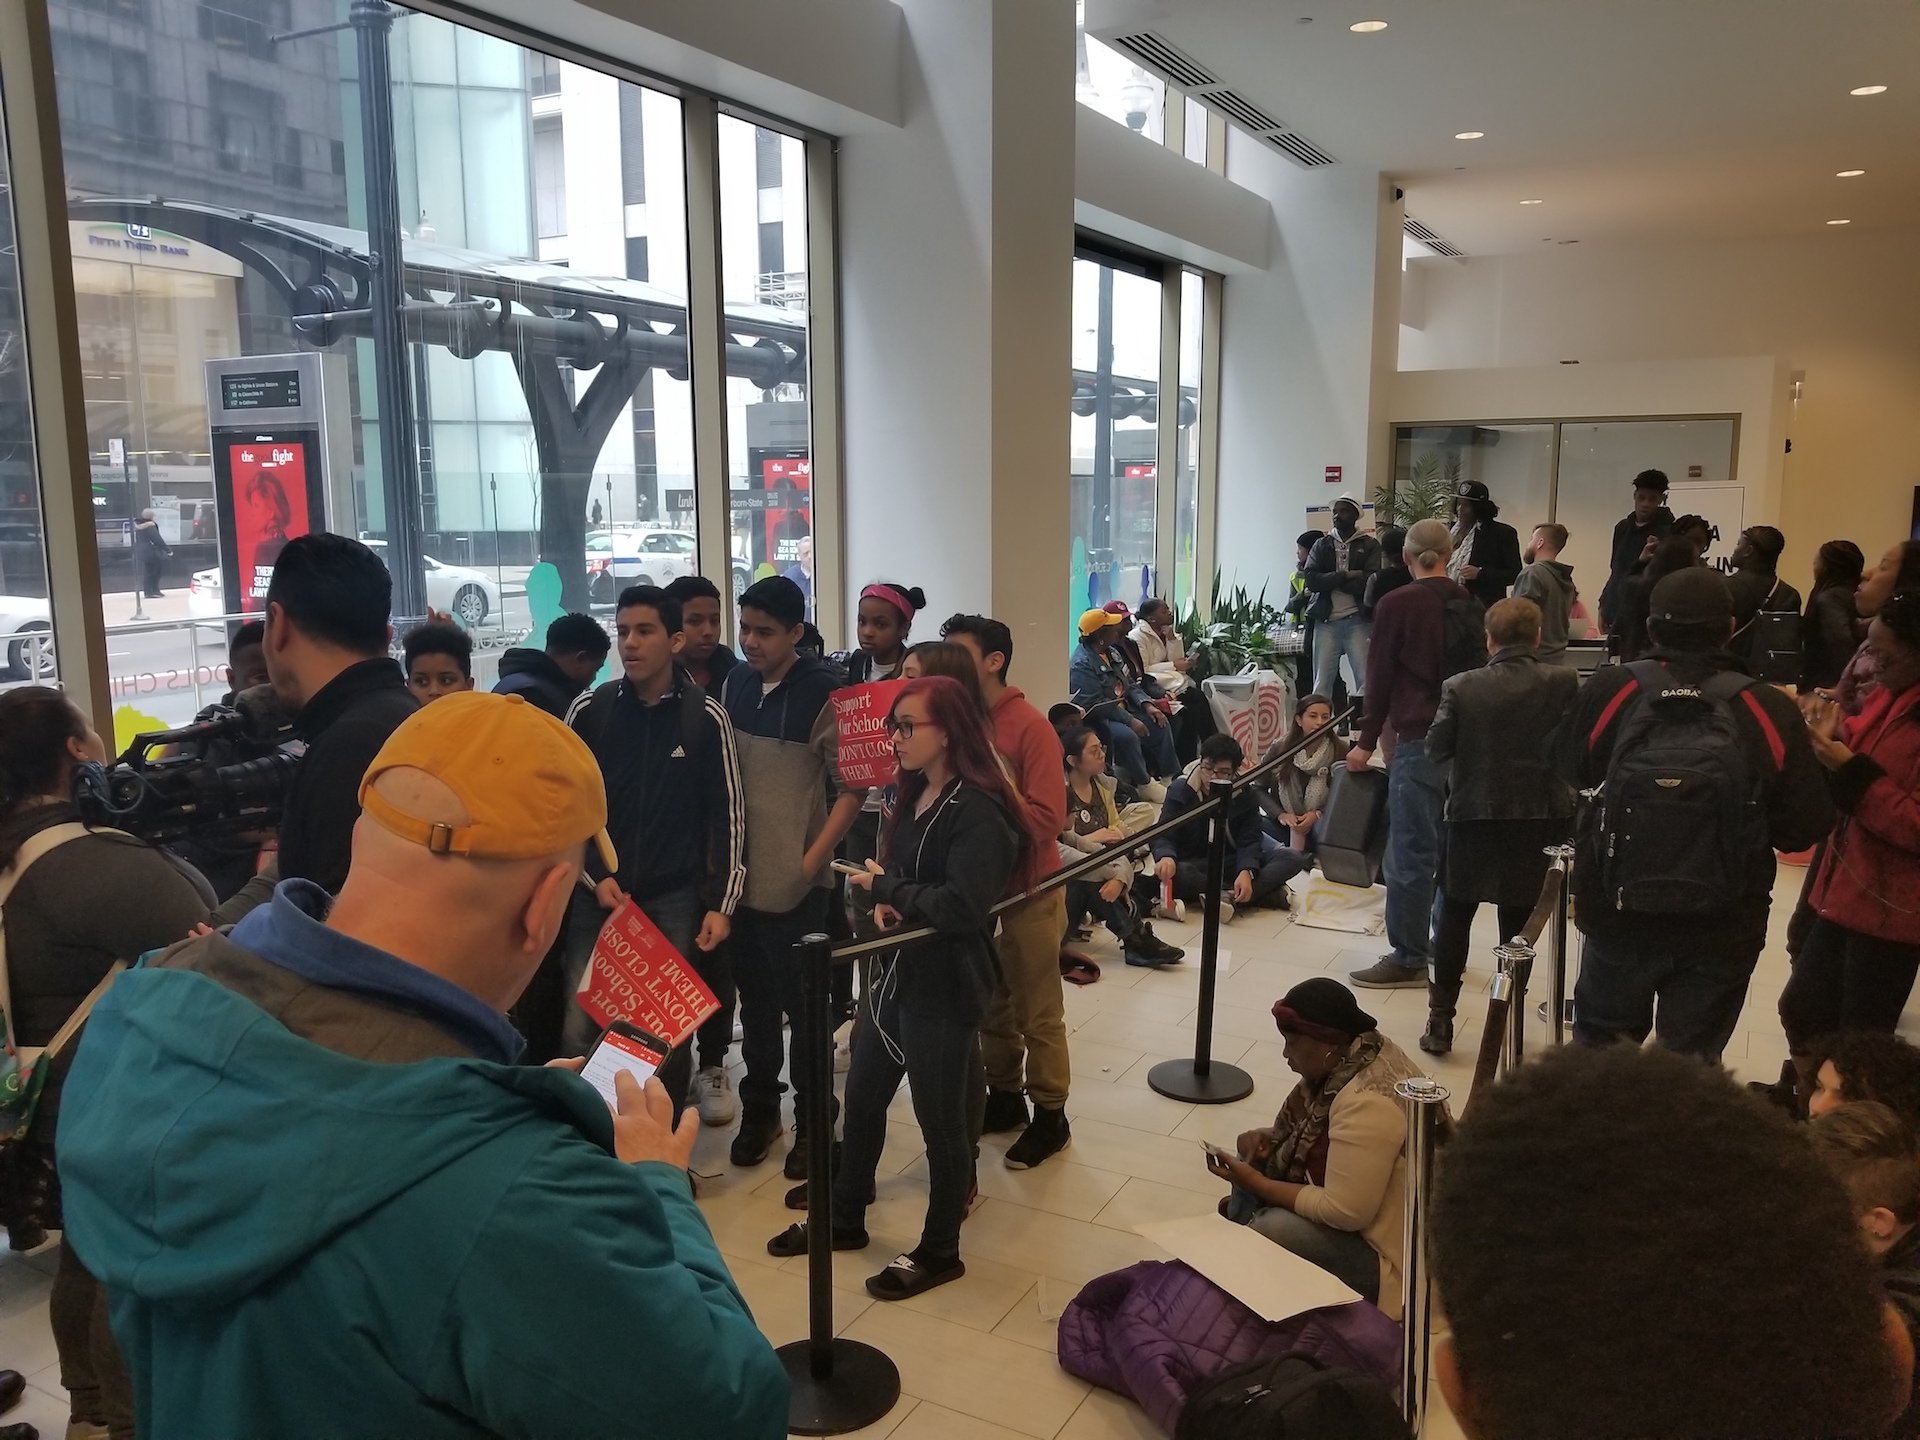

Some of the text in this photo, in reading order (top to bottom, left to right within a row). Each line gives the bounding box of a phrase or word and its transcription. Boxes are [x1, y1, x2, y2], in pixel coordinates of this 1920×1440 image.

[159, 244, 189, 257] BANK
[241, 448, 294, 466] the fight
[832, 691, 872, 716] Support
[838, 718, 852, 735] Our
[840, 763, 876, 781] THEM!
[601, 923, 696, 1031] DON'T CLOSE
[659, 958, 713, 1017] THEM!
